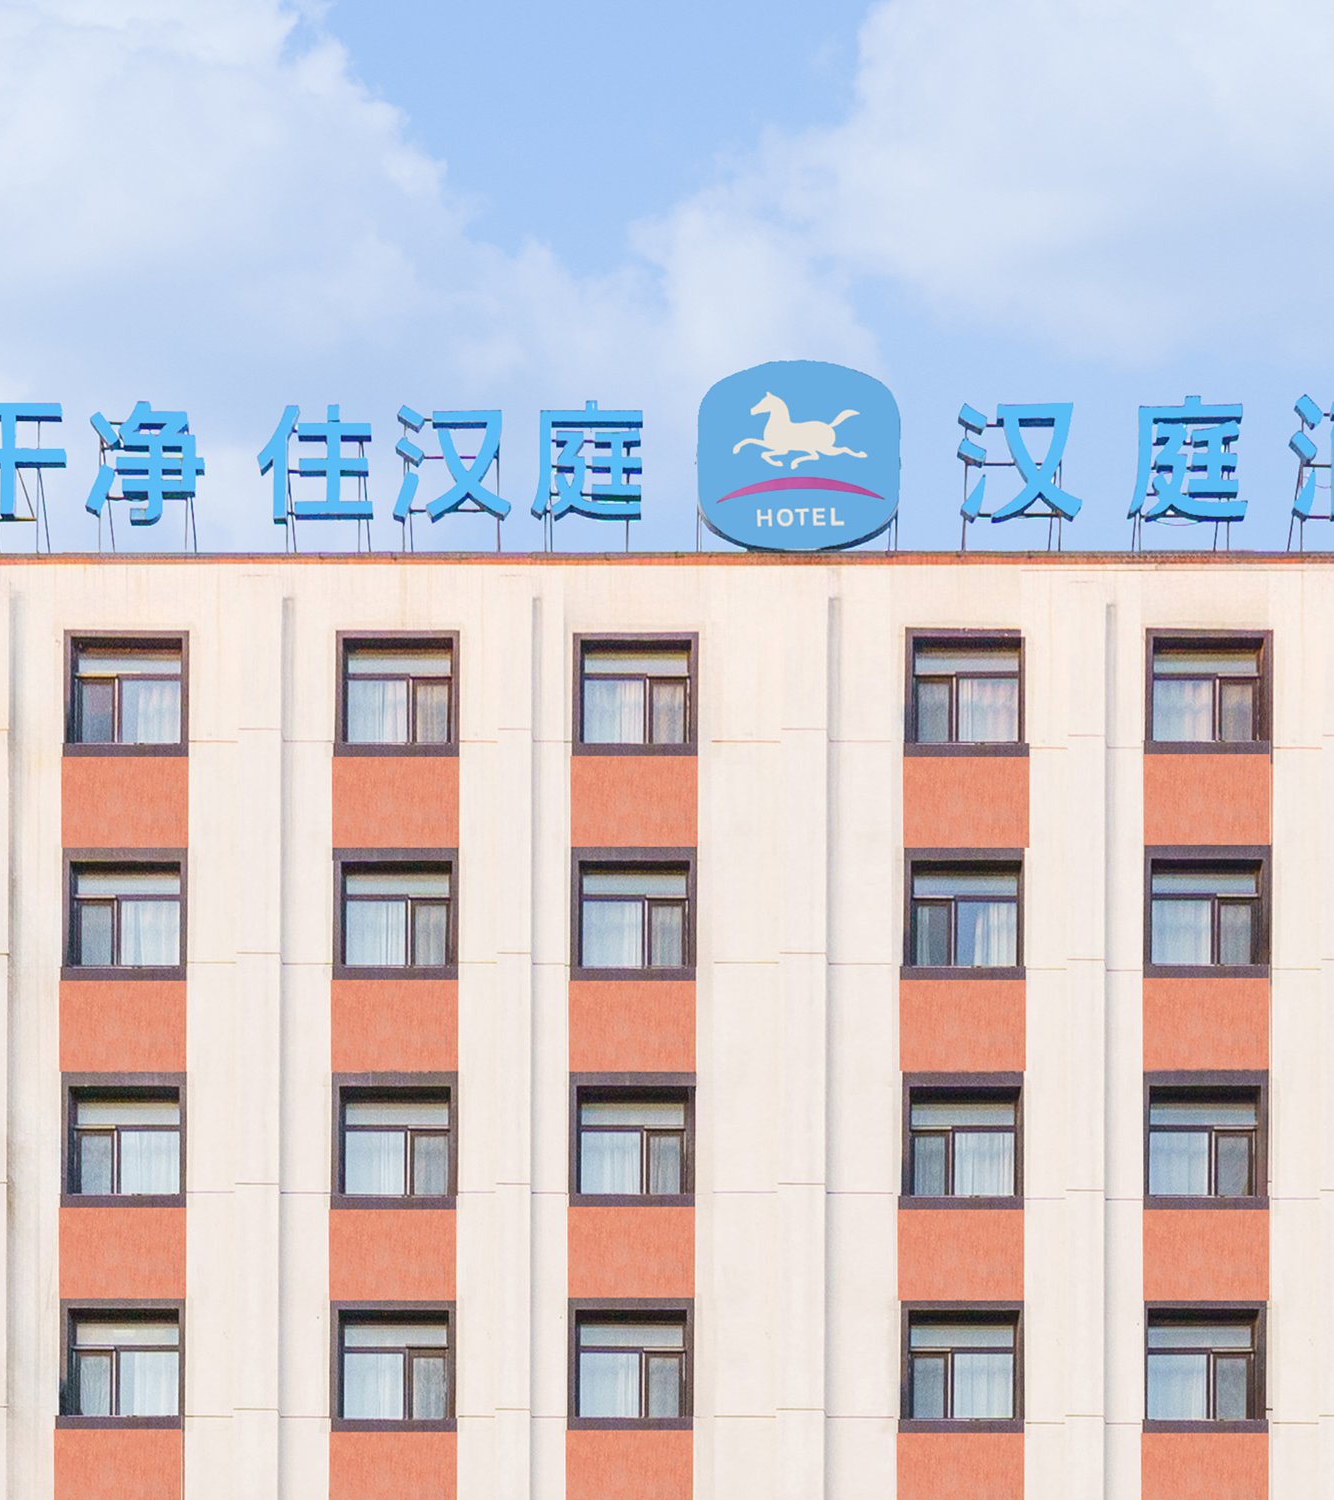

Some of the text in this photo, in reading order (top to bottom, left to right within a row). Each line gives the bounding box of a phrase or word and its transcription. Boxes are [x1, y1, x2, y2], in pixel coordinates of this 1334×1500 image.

[257, 400, 644, 525] 住汉庭
[755, 507, 846, 528] HOTEL
